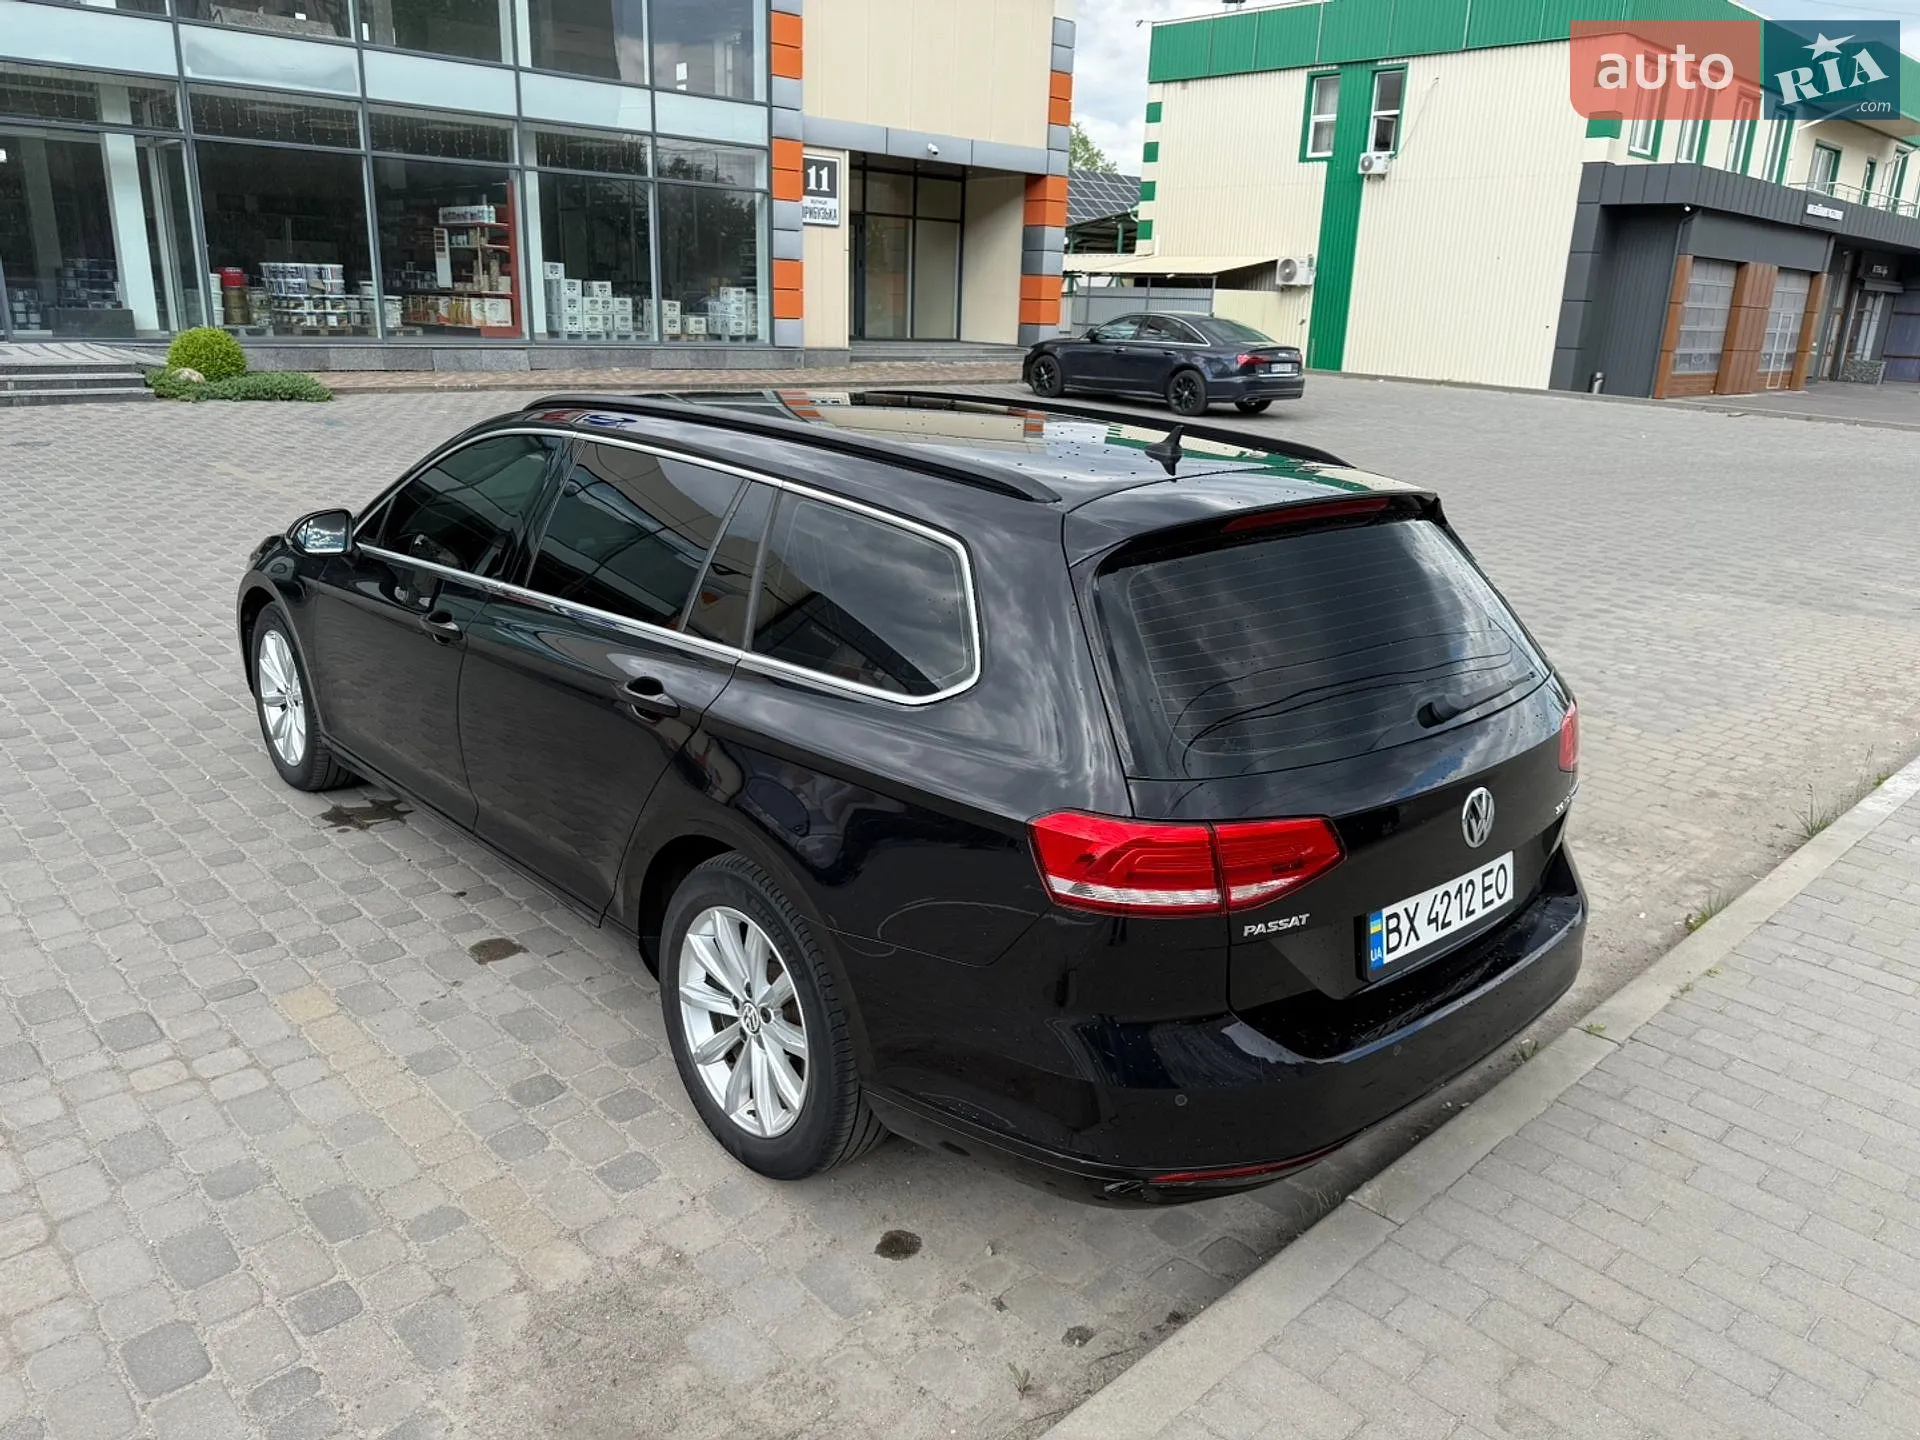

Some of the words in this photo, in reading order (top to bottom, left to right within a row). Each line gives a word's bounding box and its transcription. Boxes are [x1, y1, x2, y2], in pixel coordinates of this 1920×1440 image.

[807, 165, 830, 191] 11
[1385, 902, 1420, 955] BX
[1427, 879, 1476, 932] 4212
[1481, 863, 1508, 910] EO
[1243, 913, 1310, 937] PASSAT
[1370, 946, 1384, 962] UA
